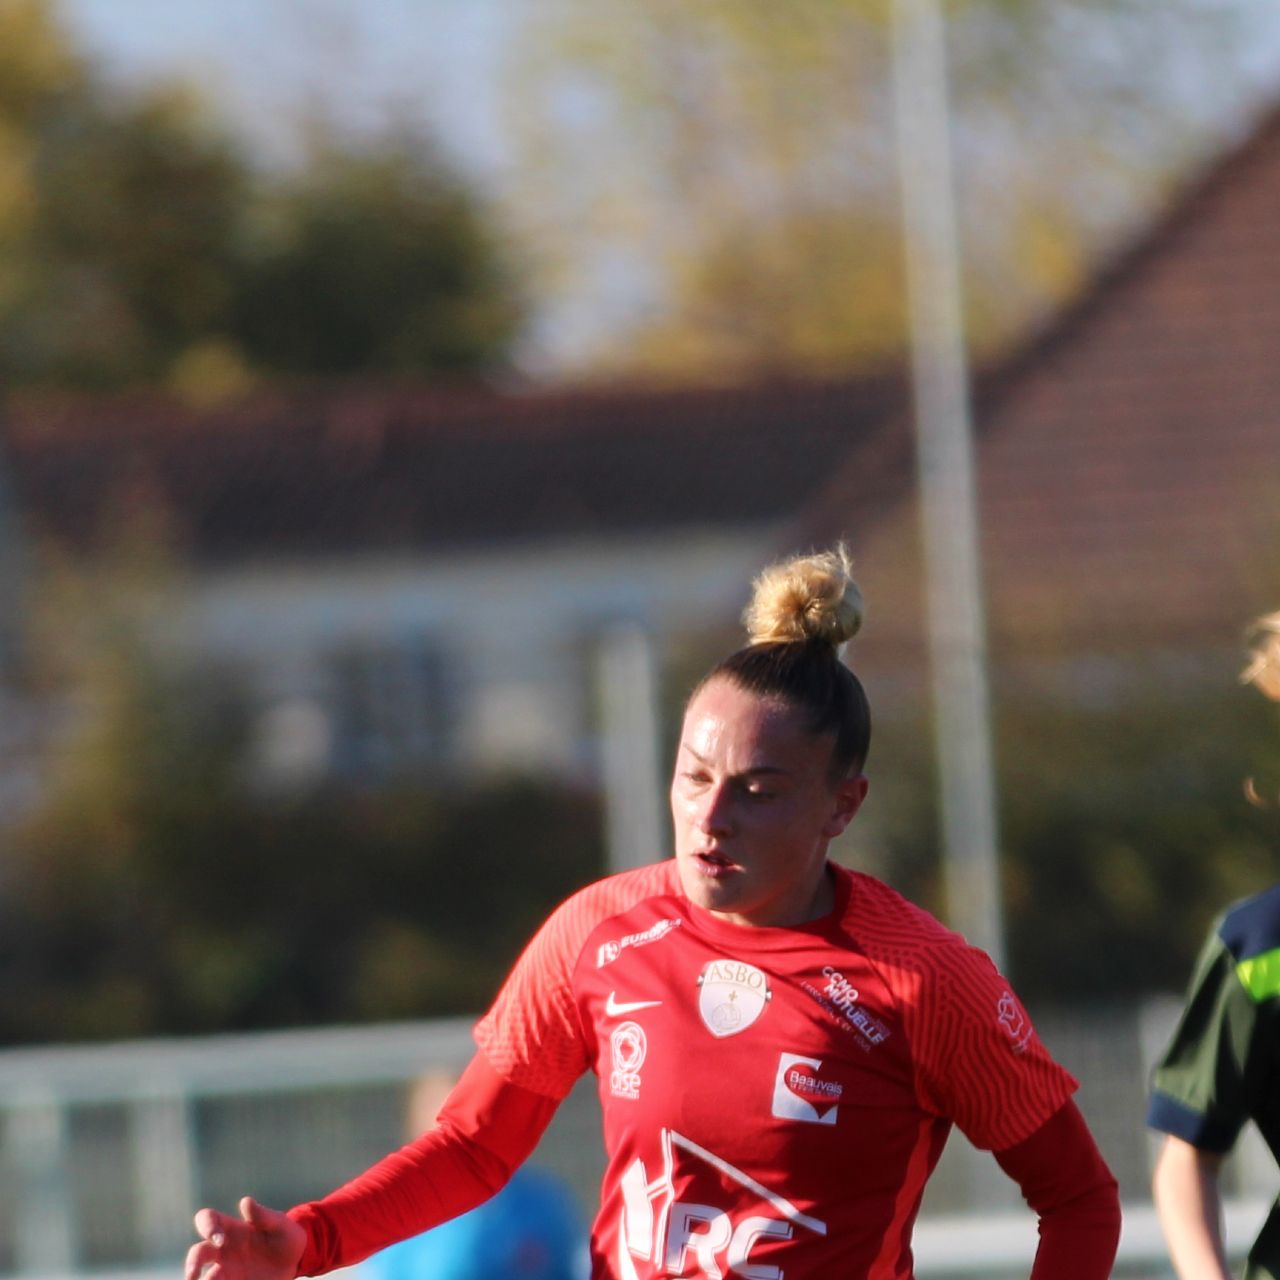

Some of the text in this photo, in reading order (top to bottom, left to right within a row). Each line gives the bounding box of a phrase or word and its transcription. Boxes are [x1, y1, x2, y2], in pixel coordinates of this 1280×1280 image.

[710, 962, 763, 989] ASBO
[822, 966, 859, 1002] CCMO
[823, 983, 885, 1044] MUTUELLE
[789, 1070, 843, 1096] Beauvais
